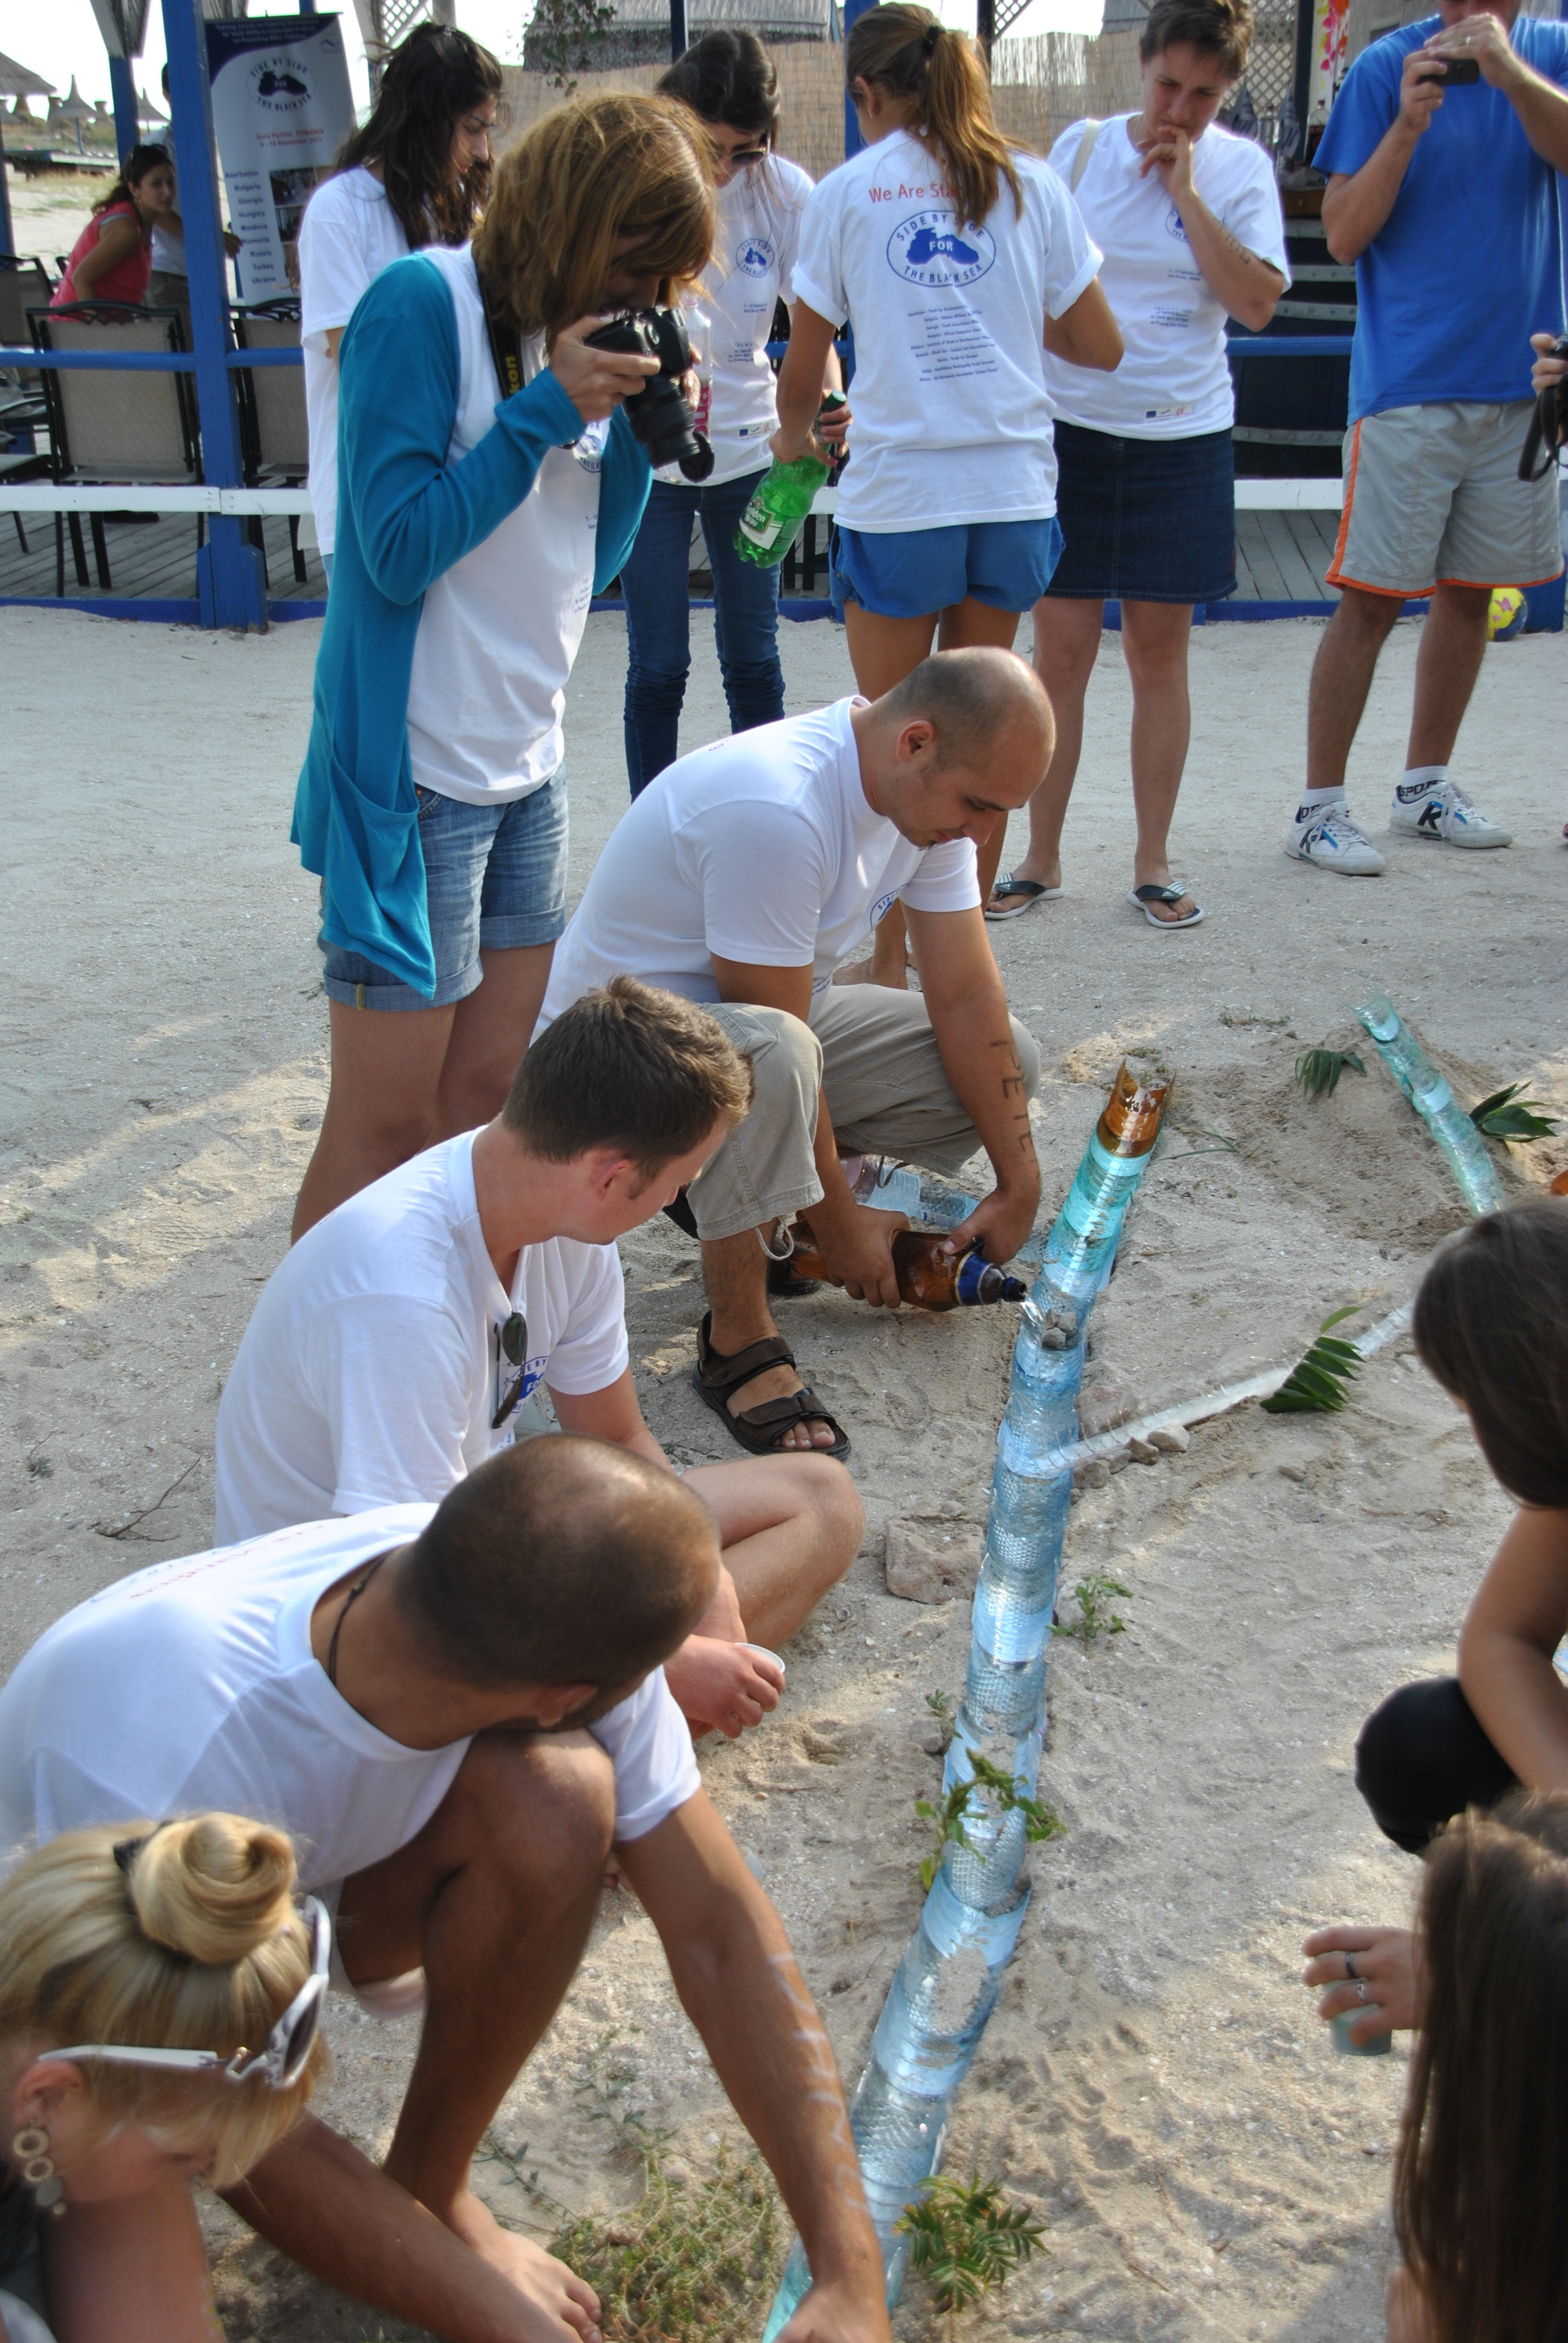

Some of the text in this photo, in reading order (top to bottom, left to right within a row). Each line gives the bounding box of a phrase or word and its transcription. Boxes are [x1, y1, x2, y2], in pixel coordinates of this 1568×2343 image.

[250, 61, 268, 78] SIDE
[287, 59, 307, 75] SIDE
[275, 79, 287, 88] FOR
[258, 94, 312, 111] THE BLACK SEA
[226, 171, 259, 179] Azerbaijan
[235, 184, 261, 192] Bulgaria
[869, 187, 892, 203] We
[898, 183, 924, 200] Are
[238, 197, 264, 206] Georgia
[239, 211, 266, 219] Hungary
[897, 215, 926, 241] SIDE
[932, 214, 947, 223] BY
[929, 241, 953, 252] FOR
[253, 262, 275, 272] Turkey
[904, 265, 924, 282] THE
[964, 264, 982, 280] SEA
[252, 276, 276, 284] Ukraine
[746, 502, 766, 523] Golden
